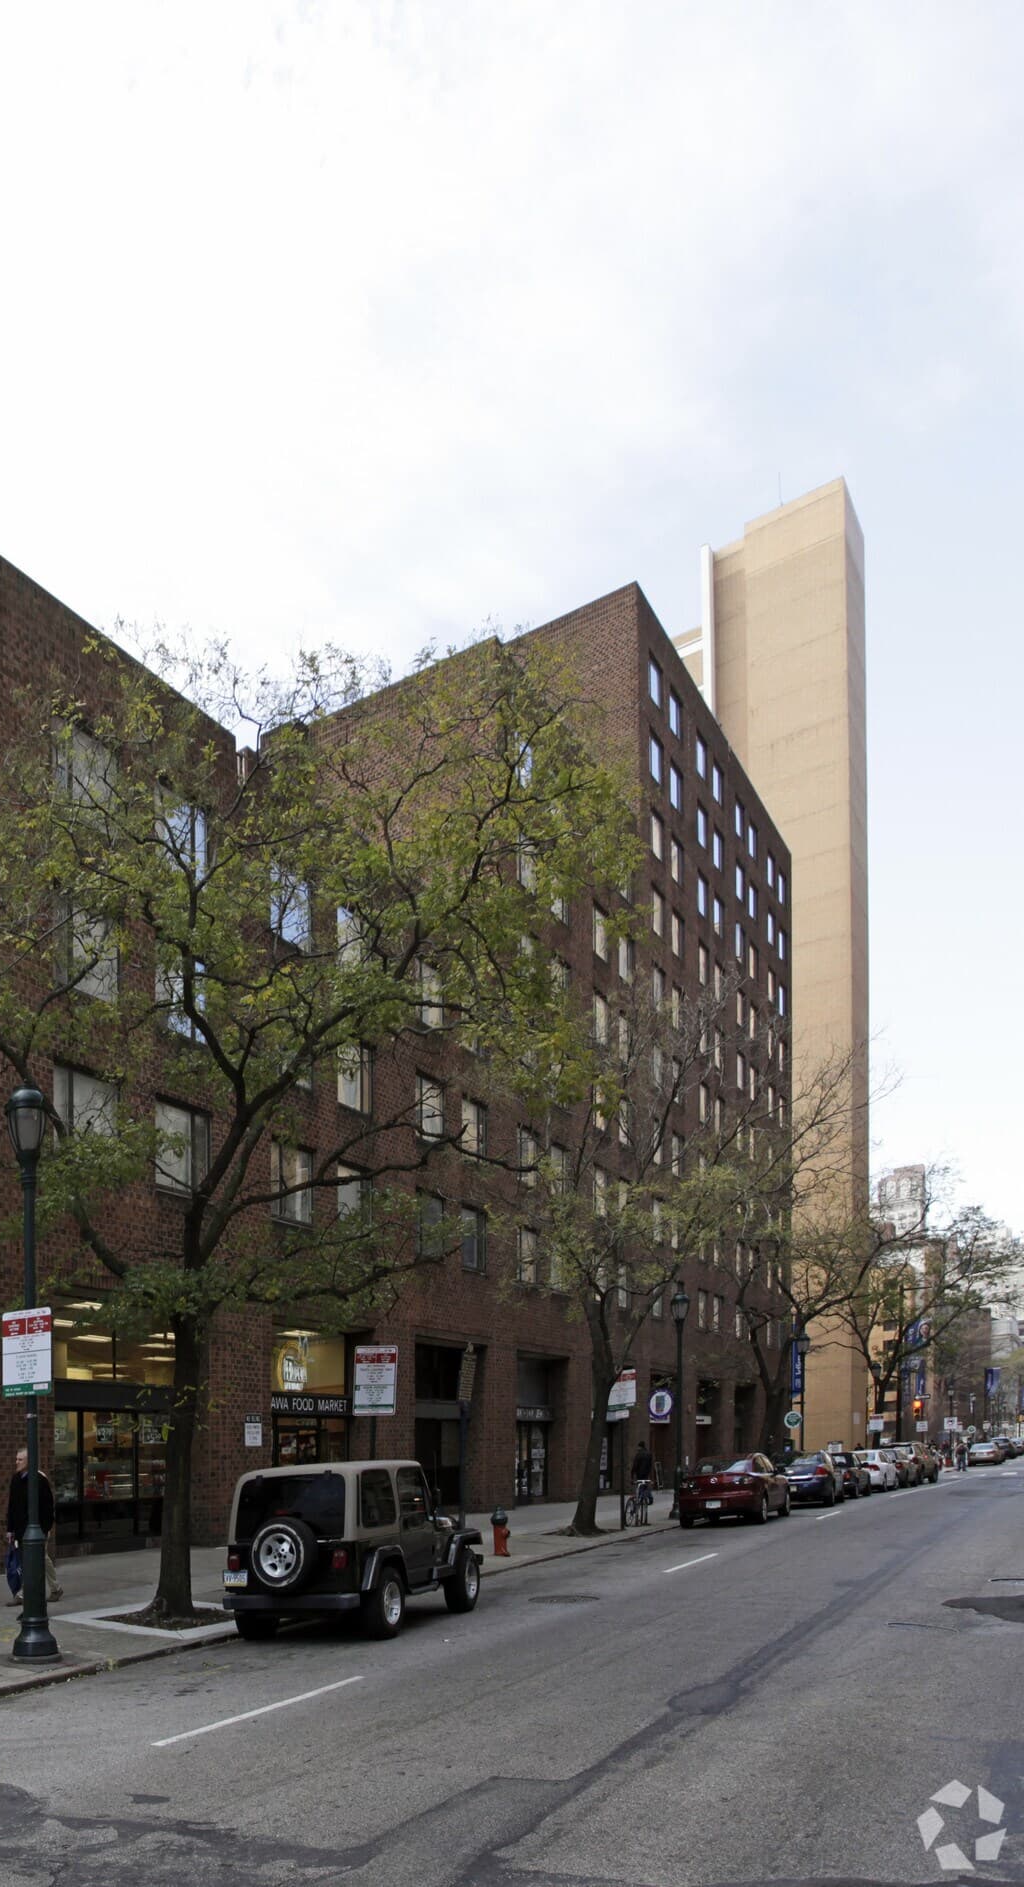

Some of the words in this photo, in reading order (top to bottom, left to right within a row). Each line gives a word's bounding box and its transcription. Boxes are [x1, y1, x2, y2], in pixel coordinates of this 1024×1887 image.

[270, 1396, 289, 1410] AWA
[292, 1397, 314, 1411] FOOD
[317, 1399, 347, 1412] MARKET
